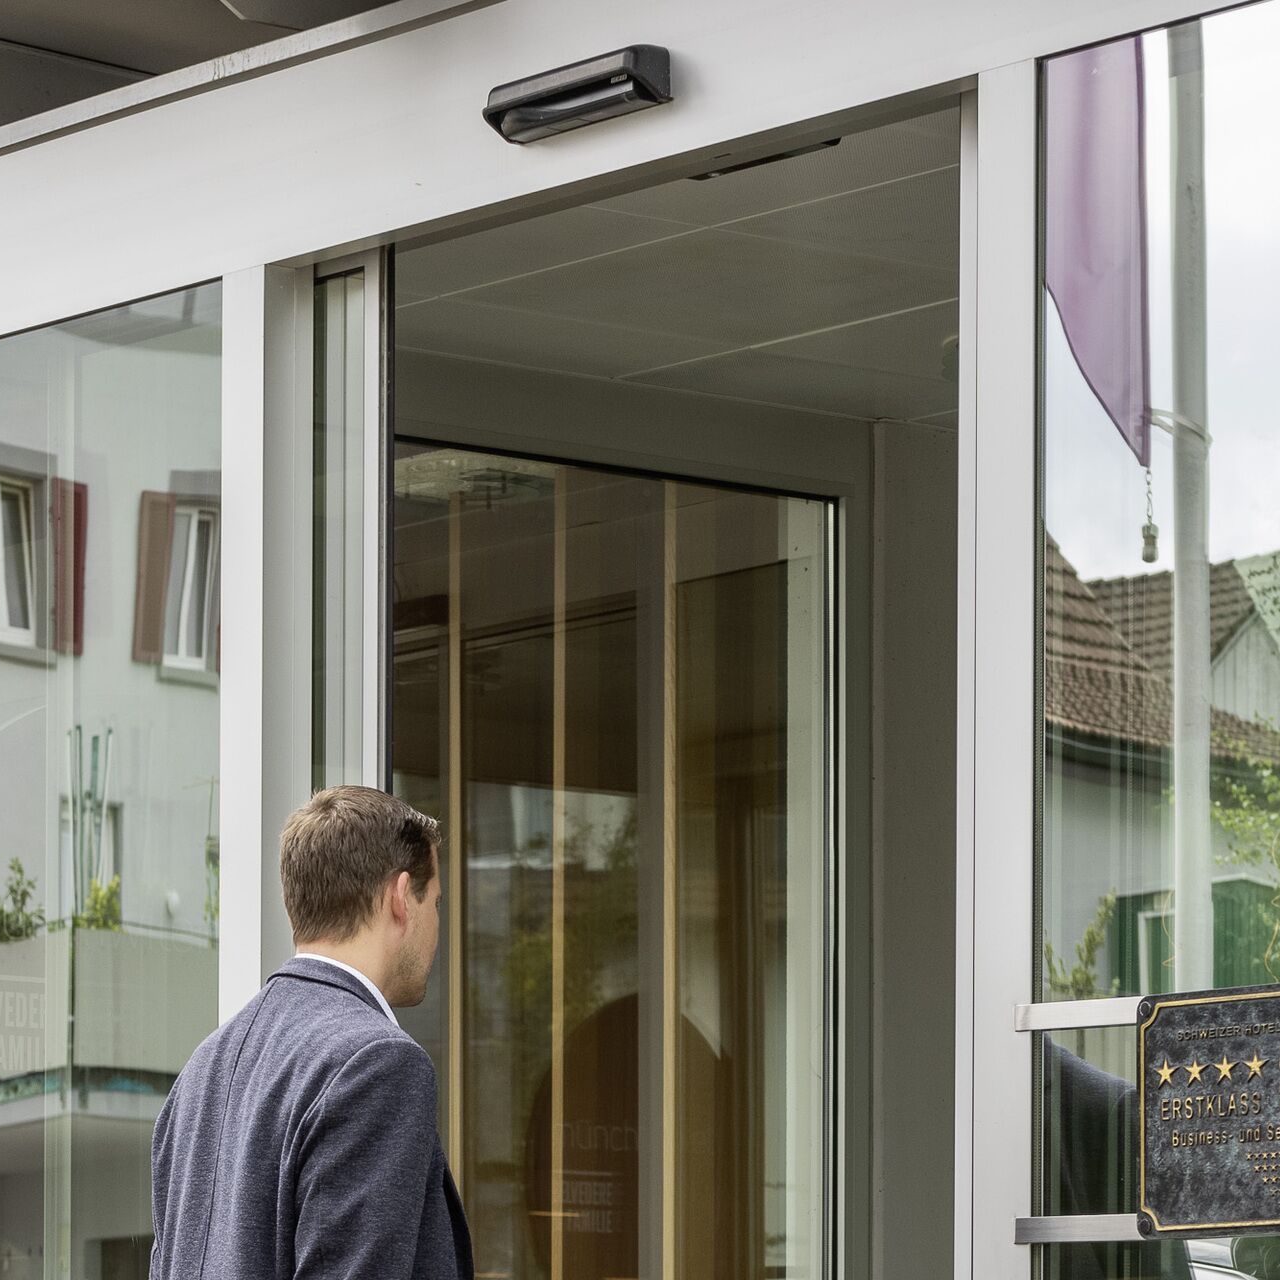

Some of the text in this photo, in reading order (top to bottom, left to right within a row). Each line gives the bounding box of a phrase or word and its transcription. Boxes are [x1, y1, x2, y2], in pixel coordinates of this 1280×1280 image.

[1177, 1026, 1241, 1041] SCHWEIZER
[1161, 1092, 1262, 1121] ERSTKLASS
[1172, 1129, 1234, 1147] Business-
[1239, 1125, 1261, 1143] und
